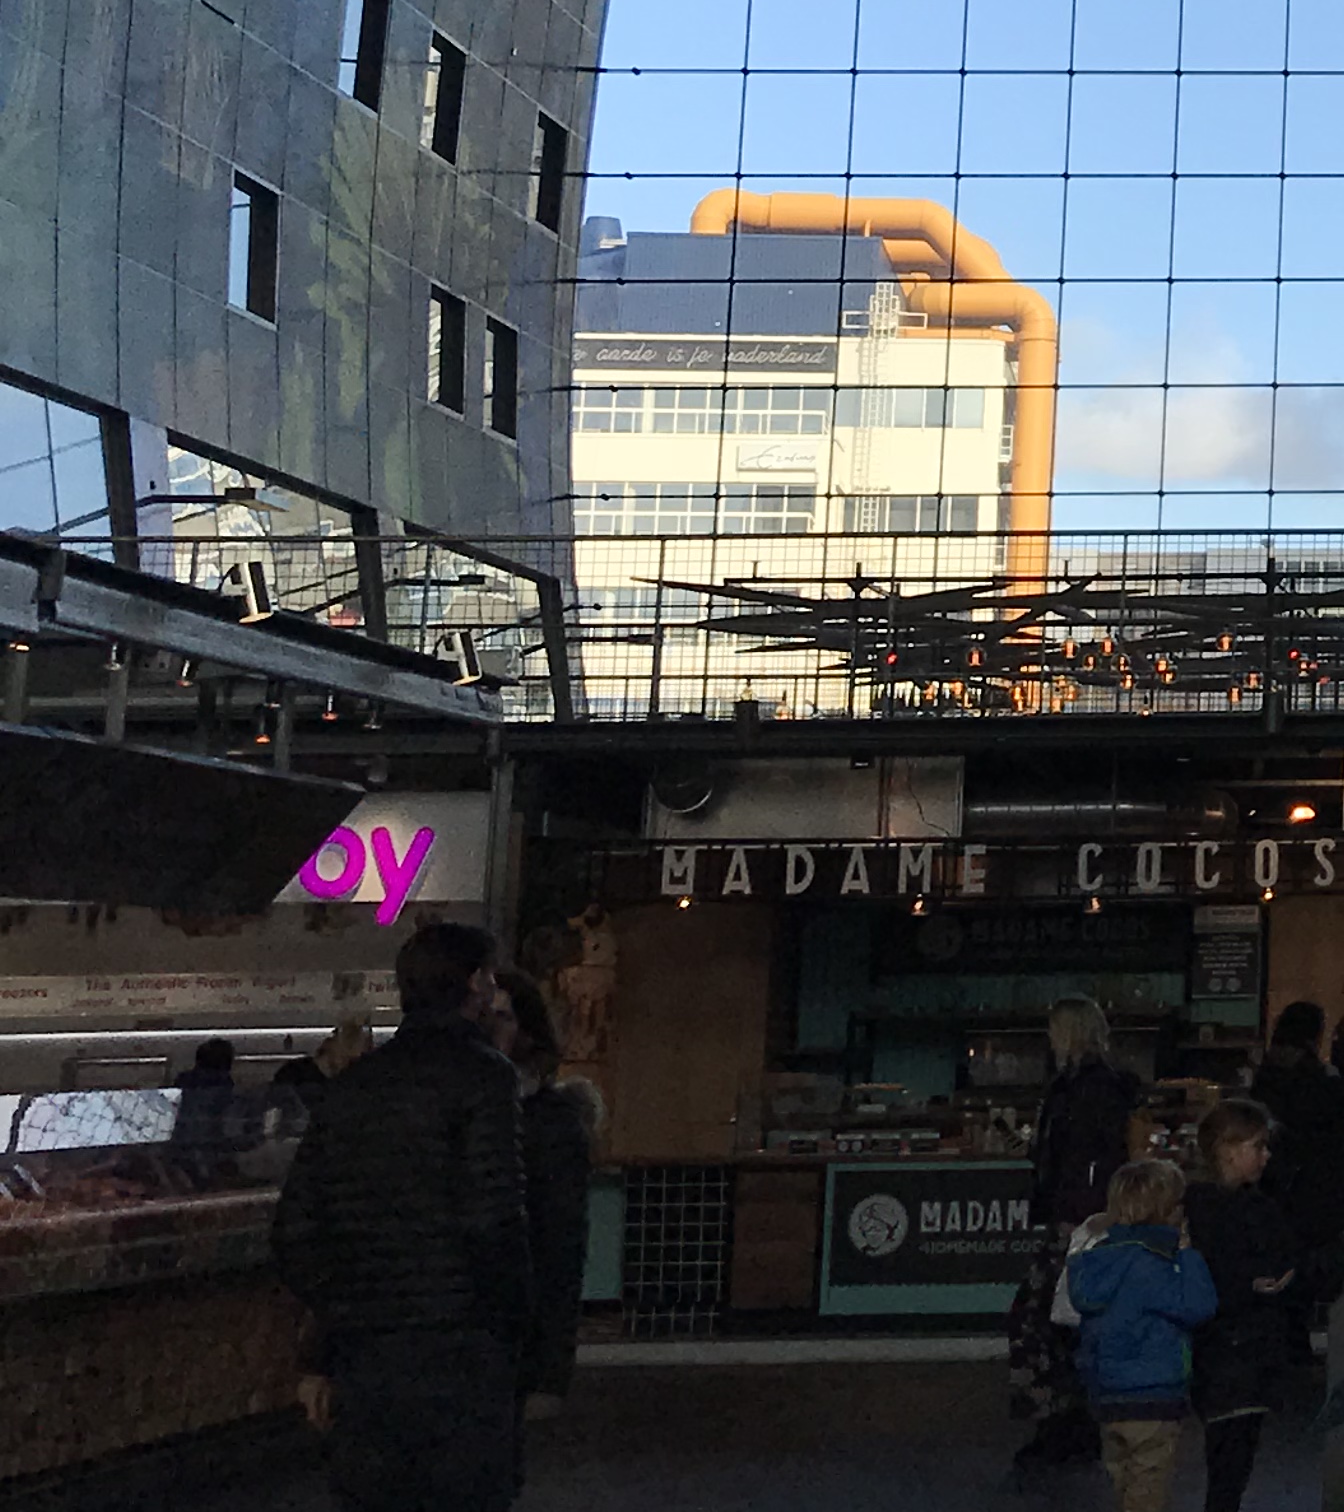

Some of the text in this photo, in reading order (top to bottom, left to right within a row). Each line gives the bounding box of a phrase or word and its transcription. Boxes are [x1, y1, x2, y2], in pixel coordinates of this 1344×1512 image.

[666, 347, 684, 363] is
[660, 838, 1337, 895] MADAME COCOS
[920, 1199, 1047, 1233] MADAM
